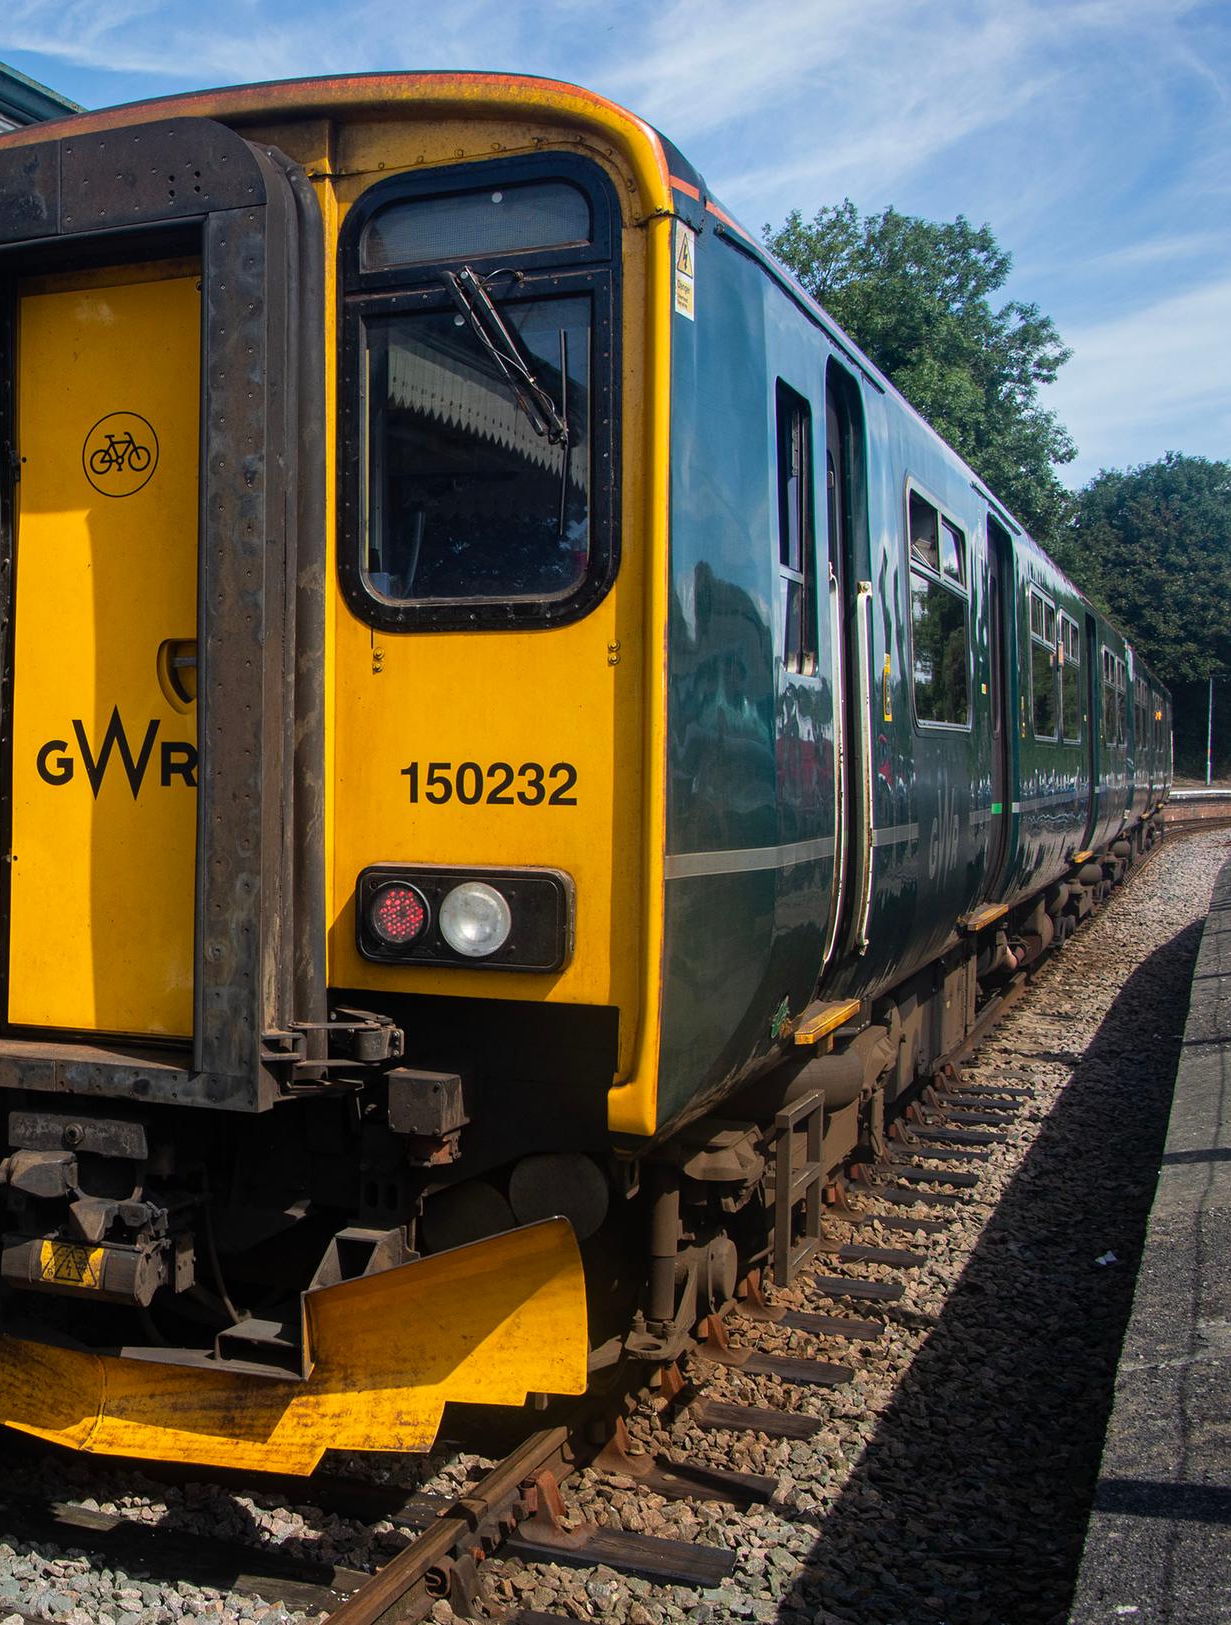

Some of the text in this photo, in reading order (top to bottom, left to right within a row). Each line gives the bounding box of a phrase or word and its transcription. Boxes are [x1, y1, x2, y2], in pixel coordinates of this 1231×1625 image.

[36, 704, 198, 801] GWR
[400, 761, 578, 806] 150232
[929, 770, 959, 893] GWR
